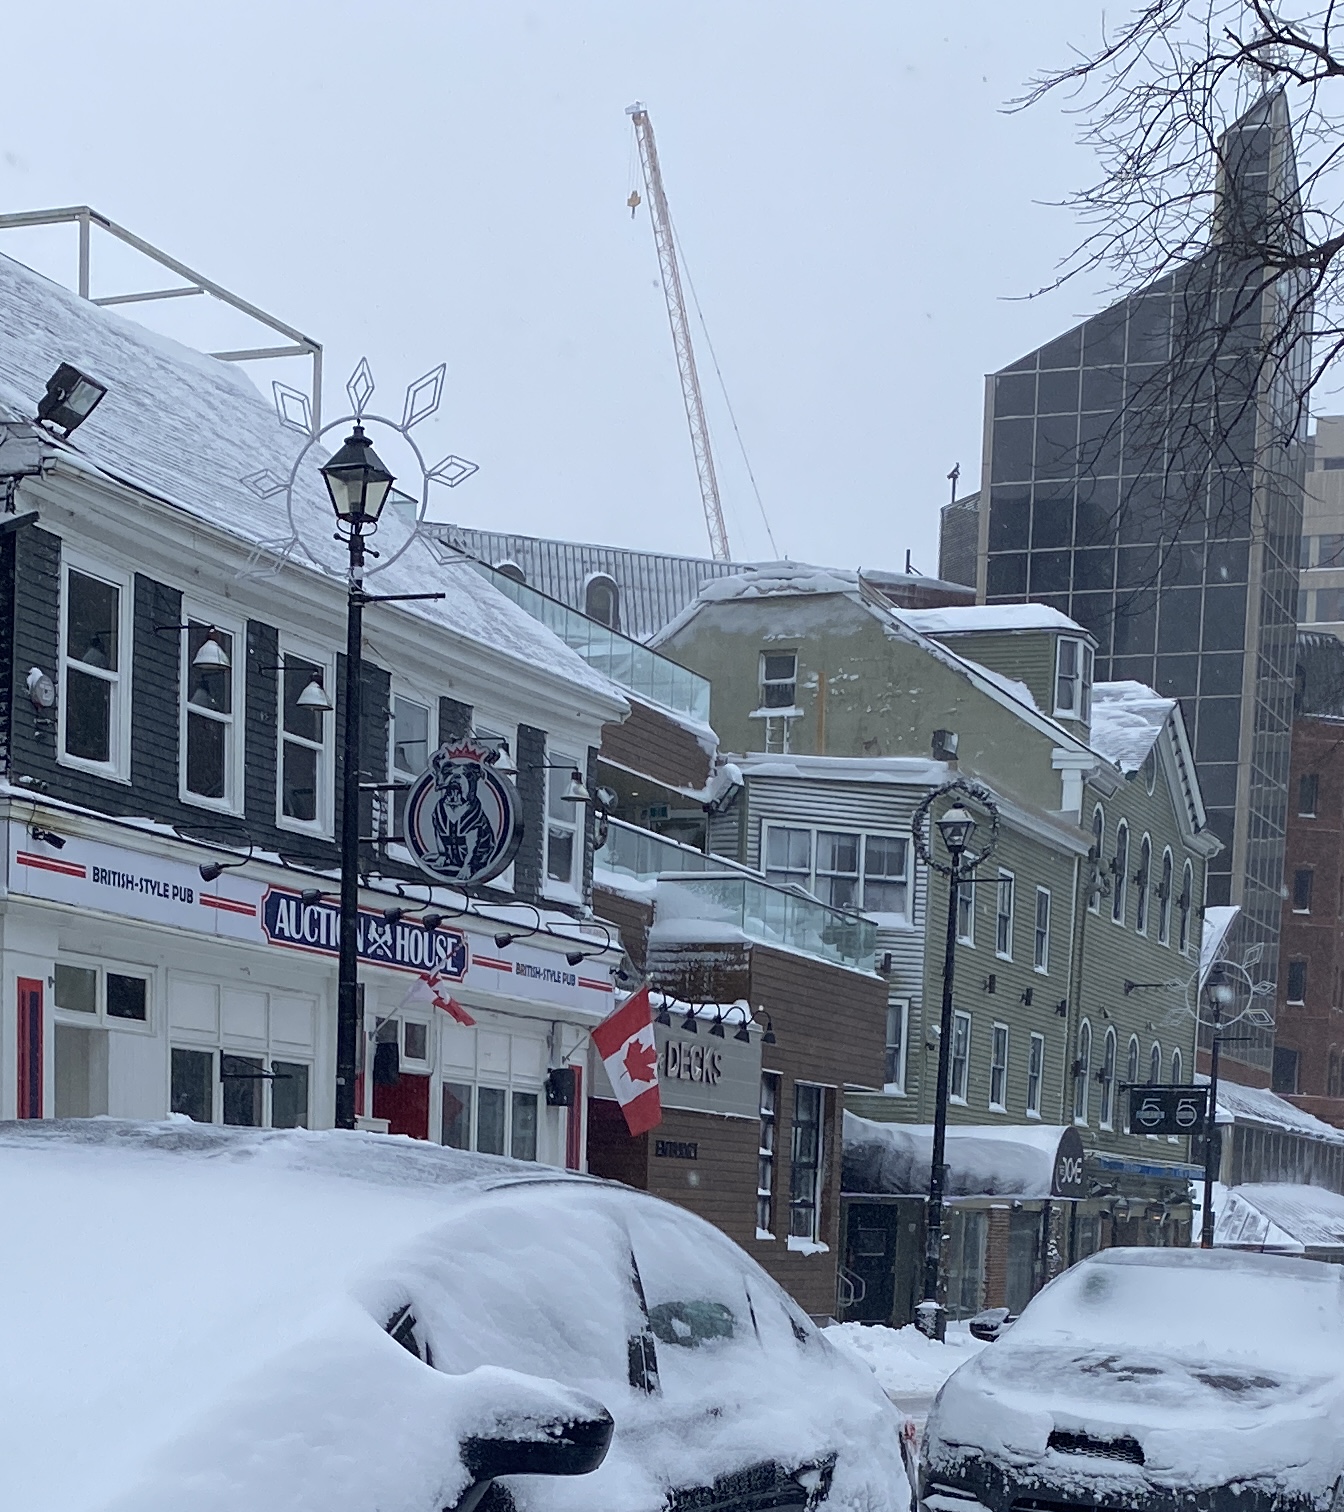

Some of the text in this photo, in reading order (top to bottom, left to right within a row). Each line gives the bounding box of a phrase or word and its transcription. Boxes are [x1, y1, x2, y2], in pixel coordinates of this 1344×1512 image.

[92, 866, 194, 904] BRITISH-STYLE PUB
[274, 897, 458, 972] AUCTIN HOUSE
[515, 961, 576, 987] BRITISH-STYLE PUB
